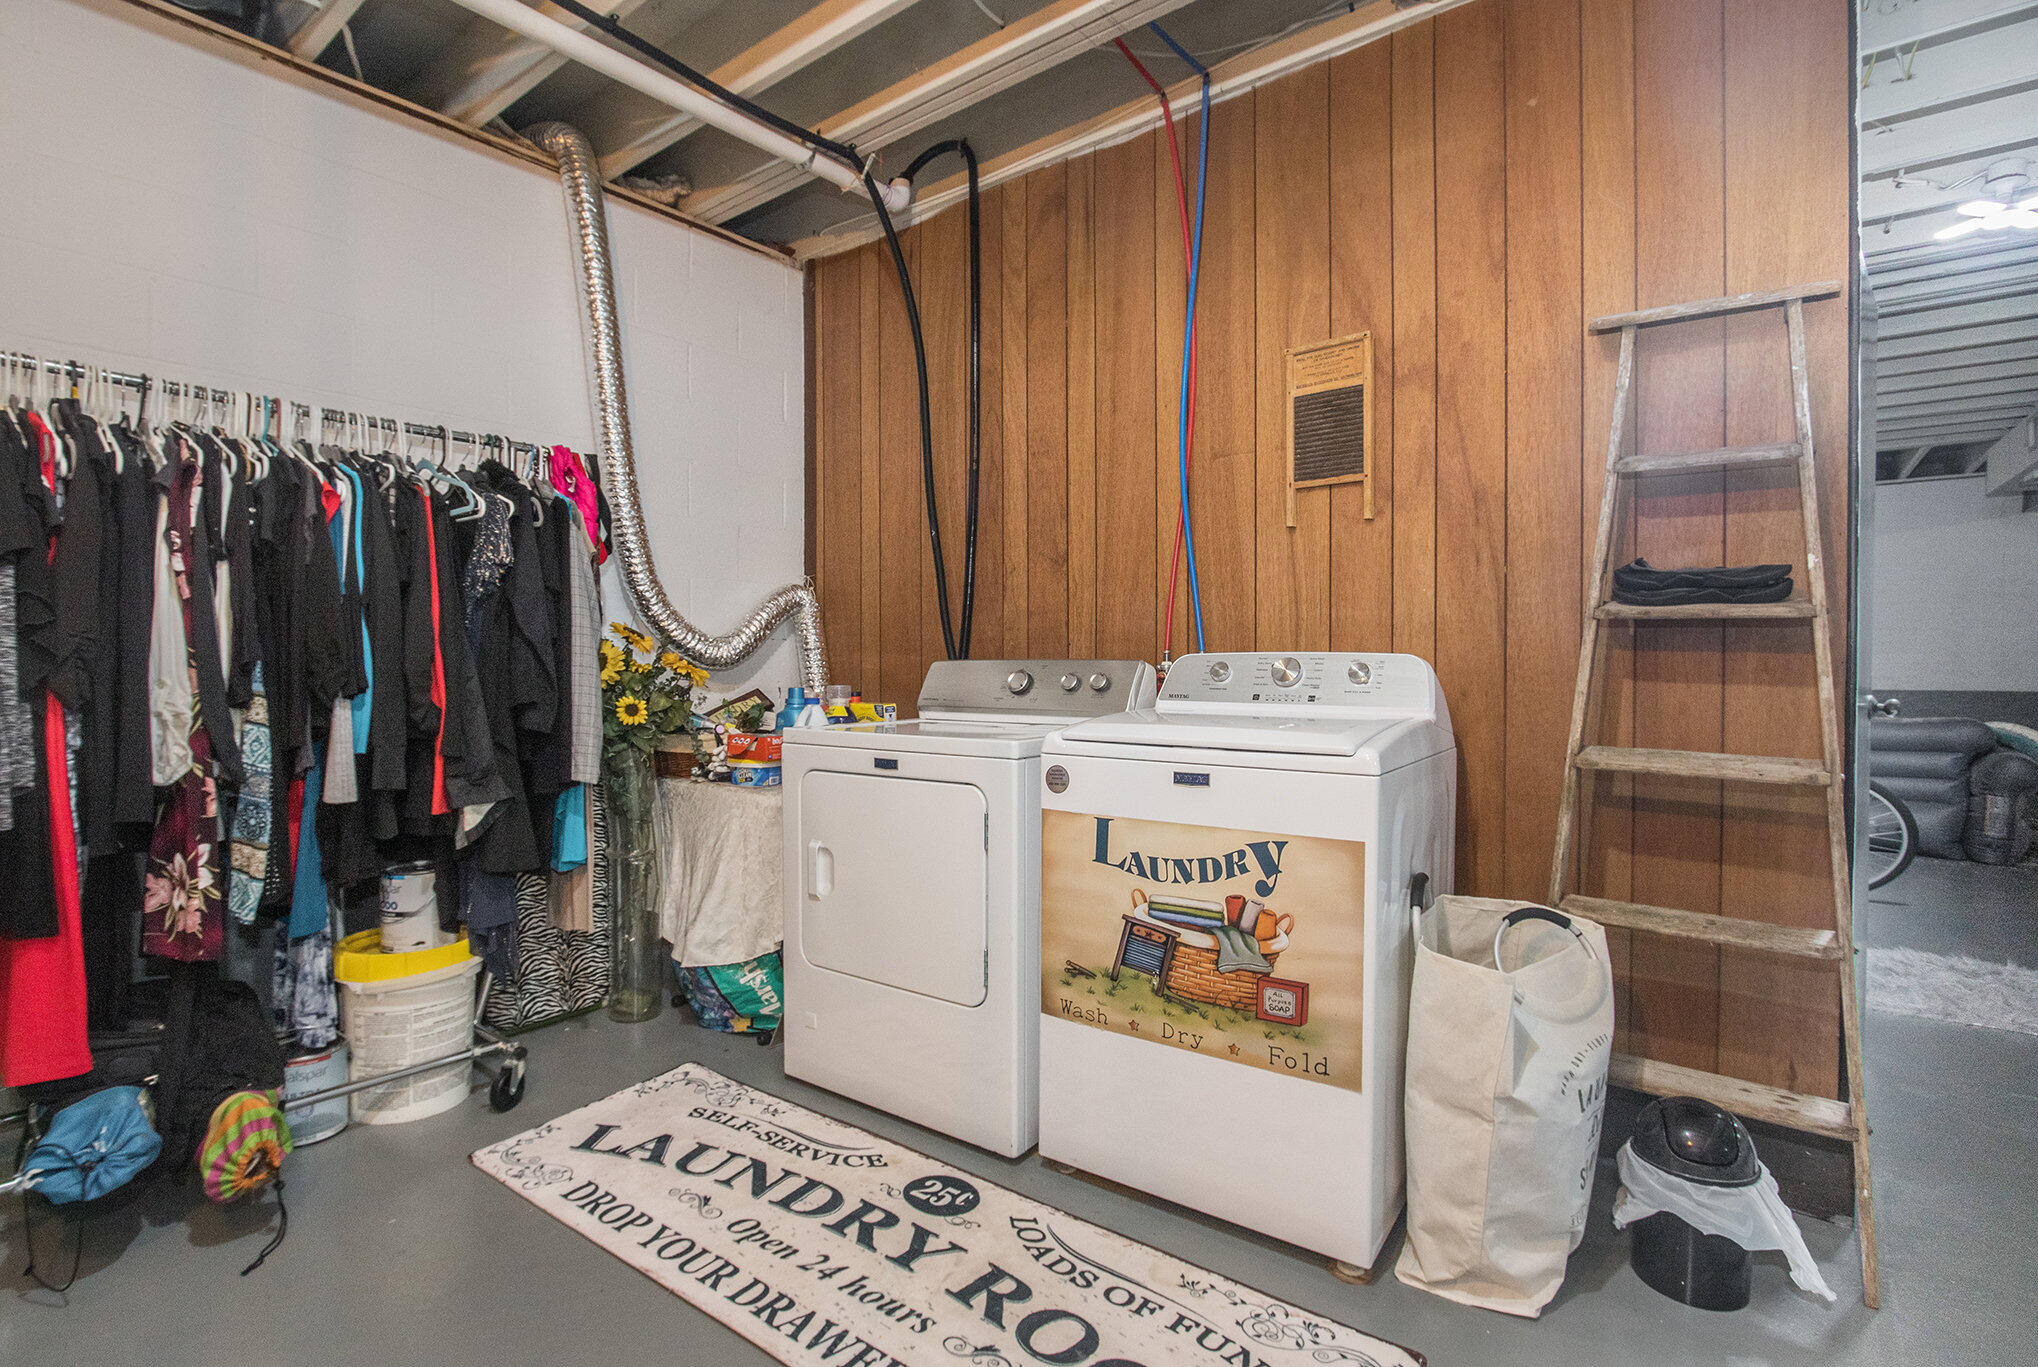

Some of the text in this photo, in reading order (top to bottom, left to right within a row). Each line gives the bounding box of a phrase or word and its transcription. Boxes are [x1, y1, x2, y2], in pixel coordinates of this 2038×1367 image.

[1059, 998, 1331, 1077] Wash Dry Fold
[1268, 1003, 1291, 1014] SOAP
[687, 1105, 888, 1169] SELF-SERVICE
[561, 1180, 909, 1367] DROP YOUR DRAWE
[570, 1123, 1152, 1367] LAUNDRY RO
[727, 1217, 937, 1334] Open 24 hours
[1009, 1215, 1100, 1289] LOADS
[1103, 1286, 1165, 1317] OF
